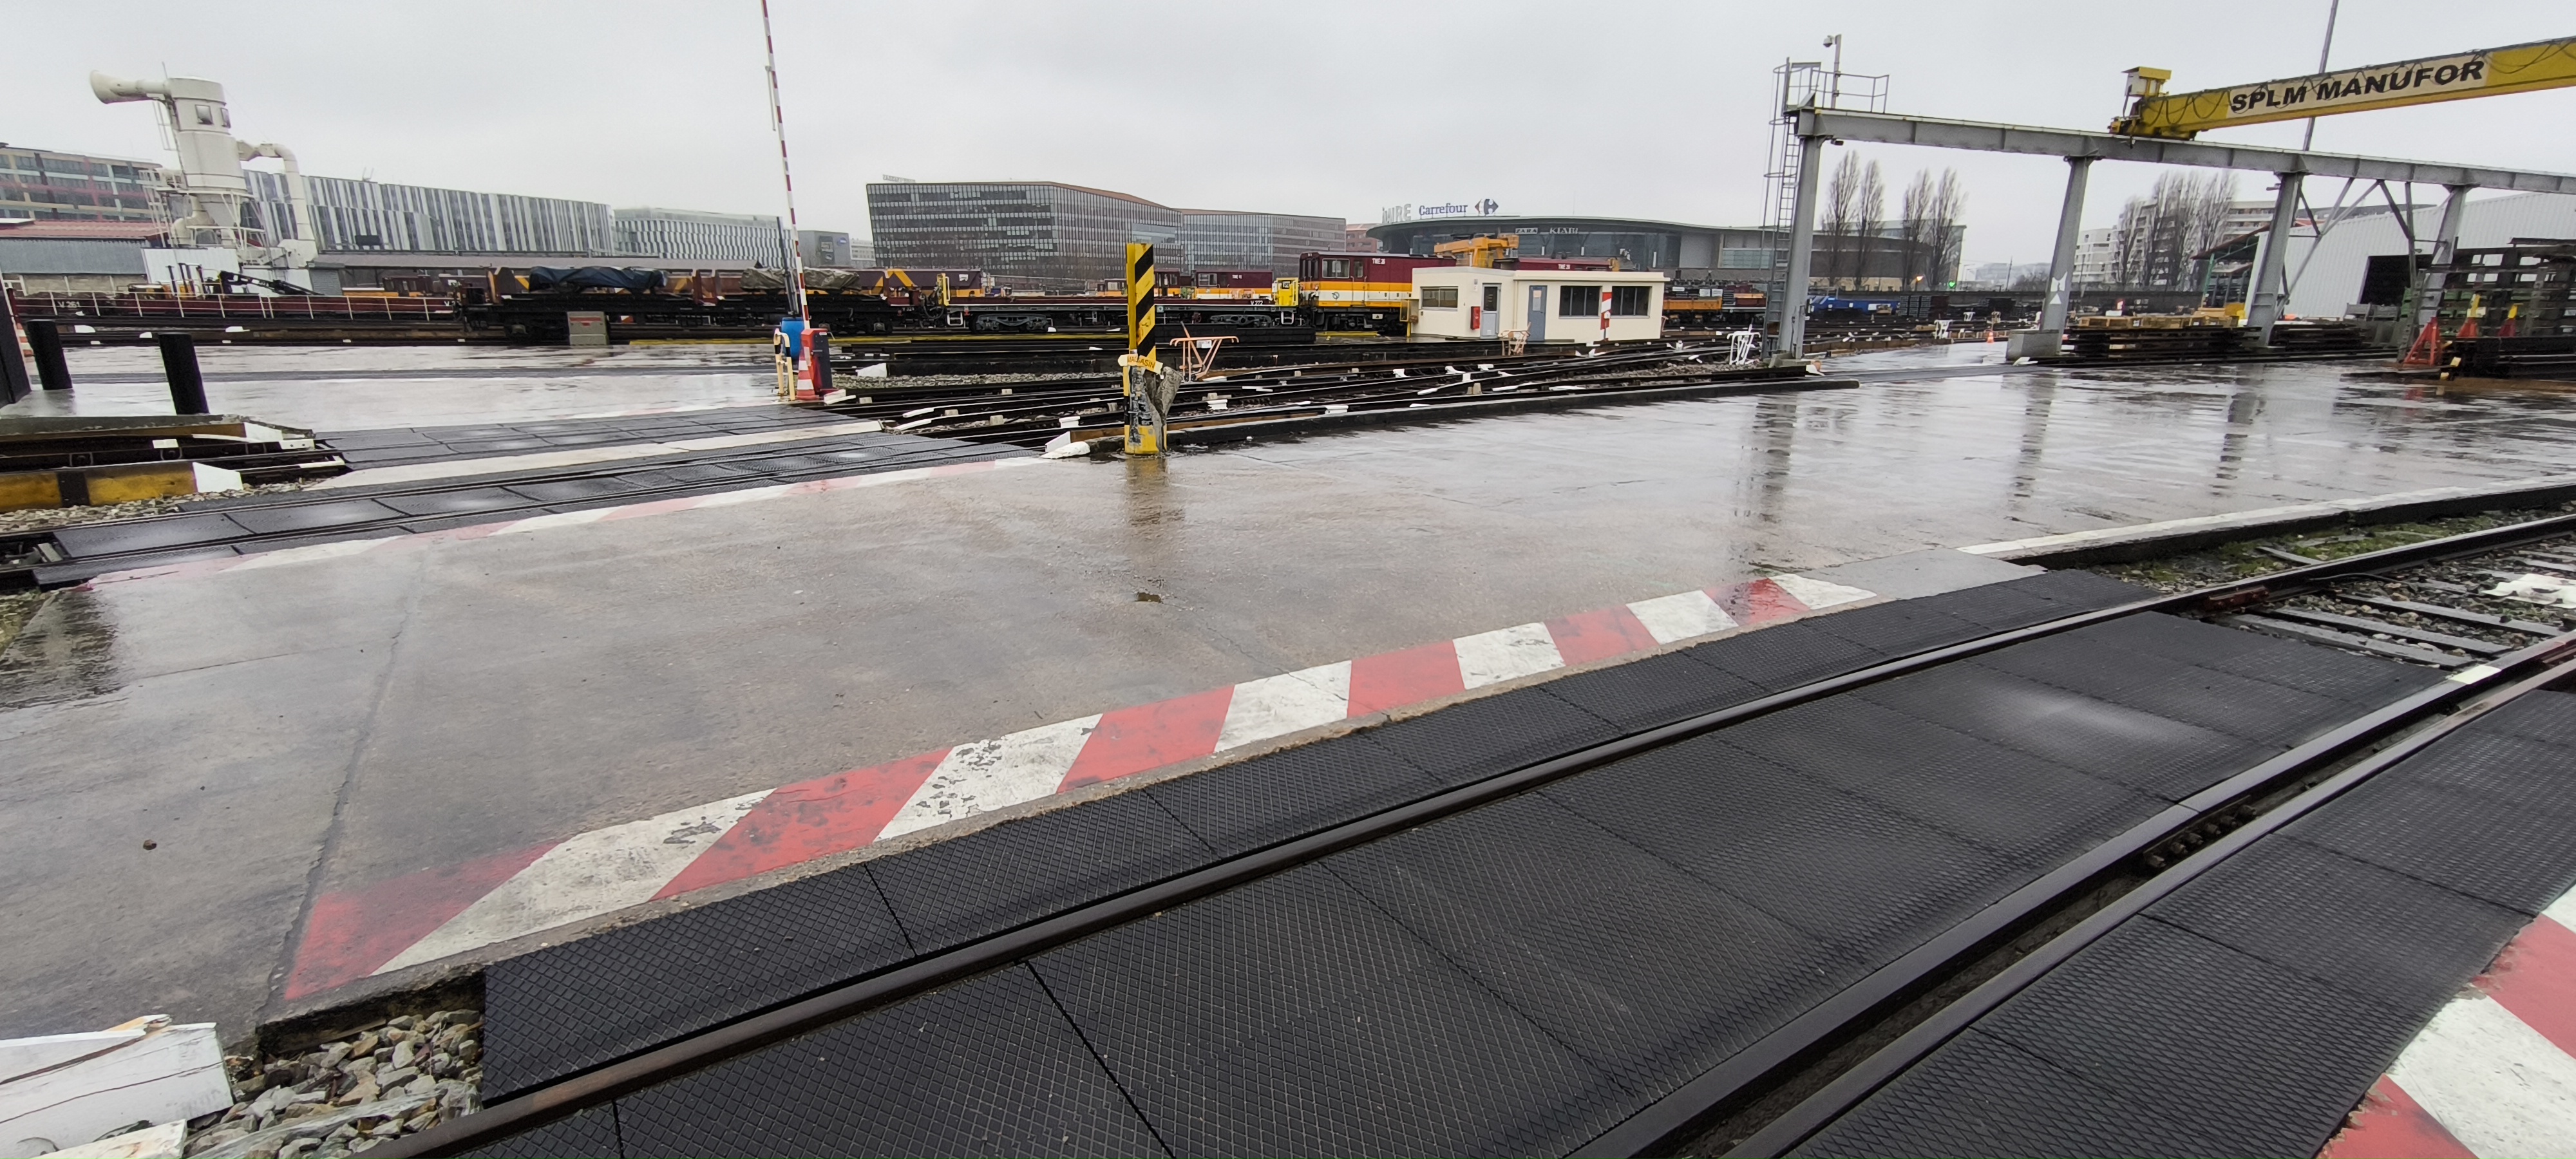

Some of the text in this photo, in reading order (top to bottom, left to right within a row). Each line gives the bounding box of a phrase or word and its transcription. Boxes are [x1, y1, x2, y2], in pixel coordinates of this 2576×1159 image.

[2231, 61, 2485, 112] SPLM MANUFOR
[1419, 203, 1468, 216] Carrefour
